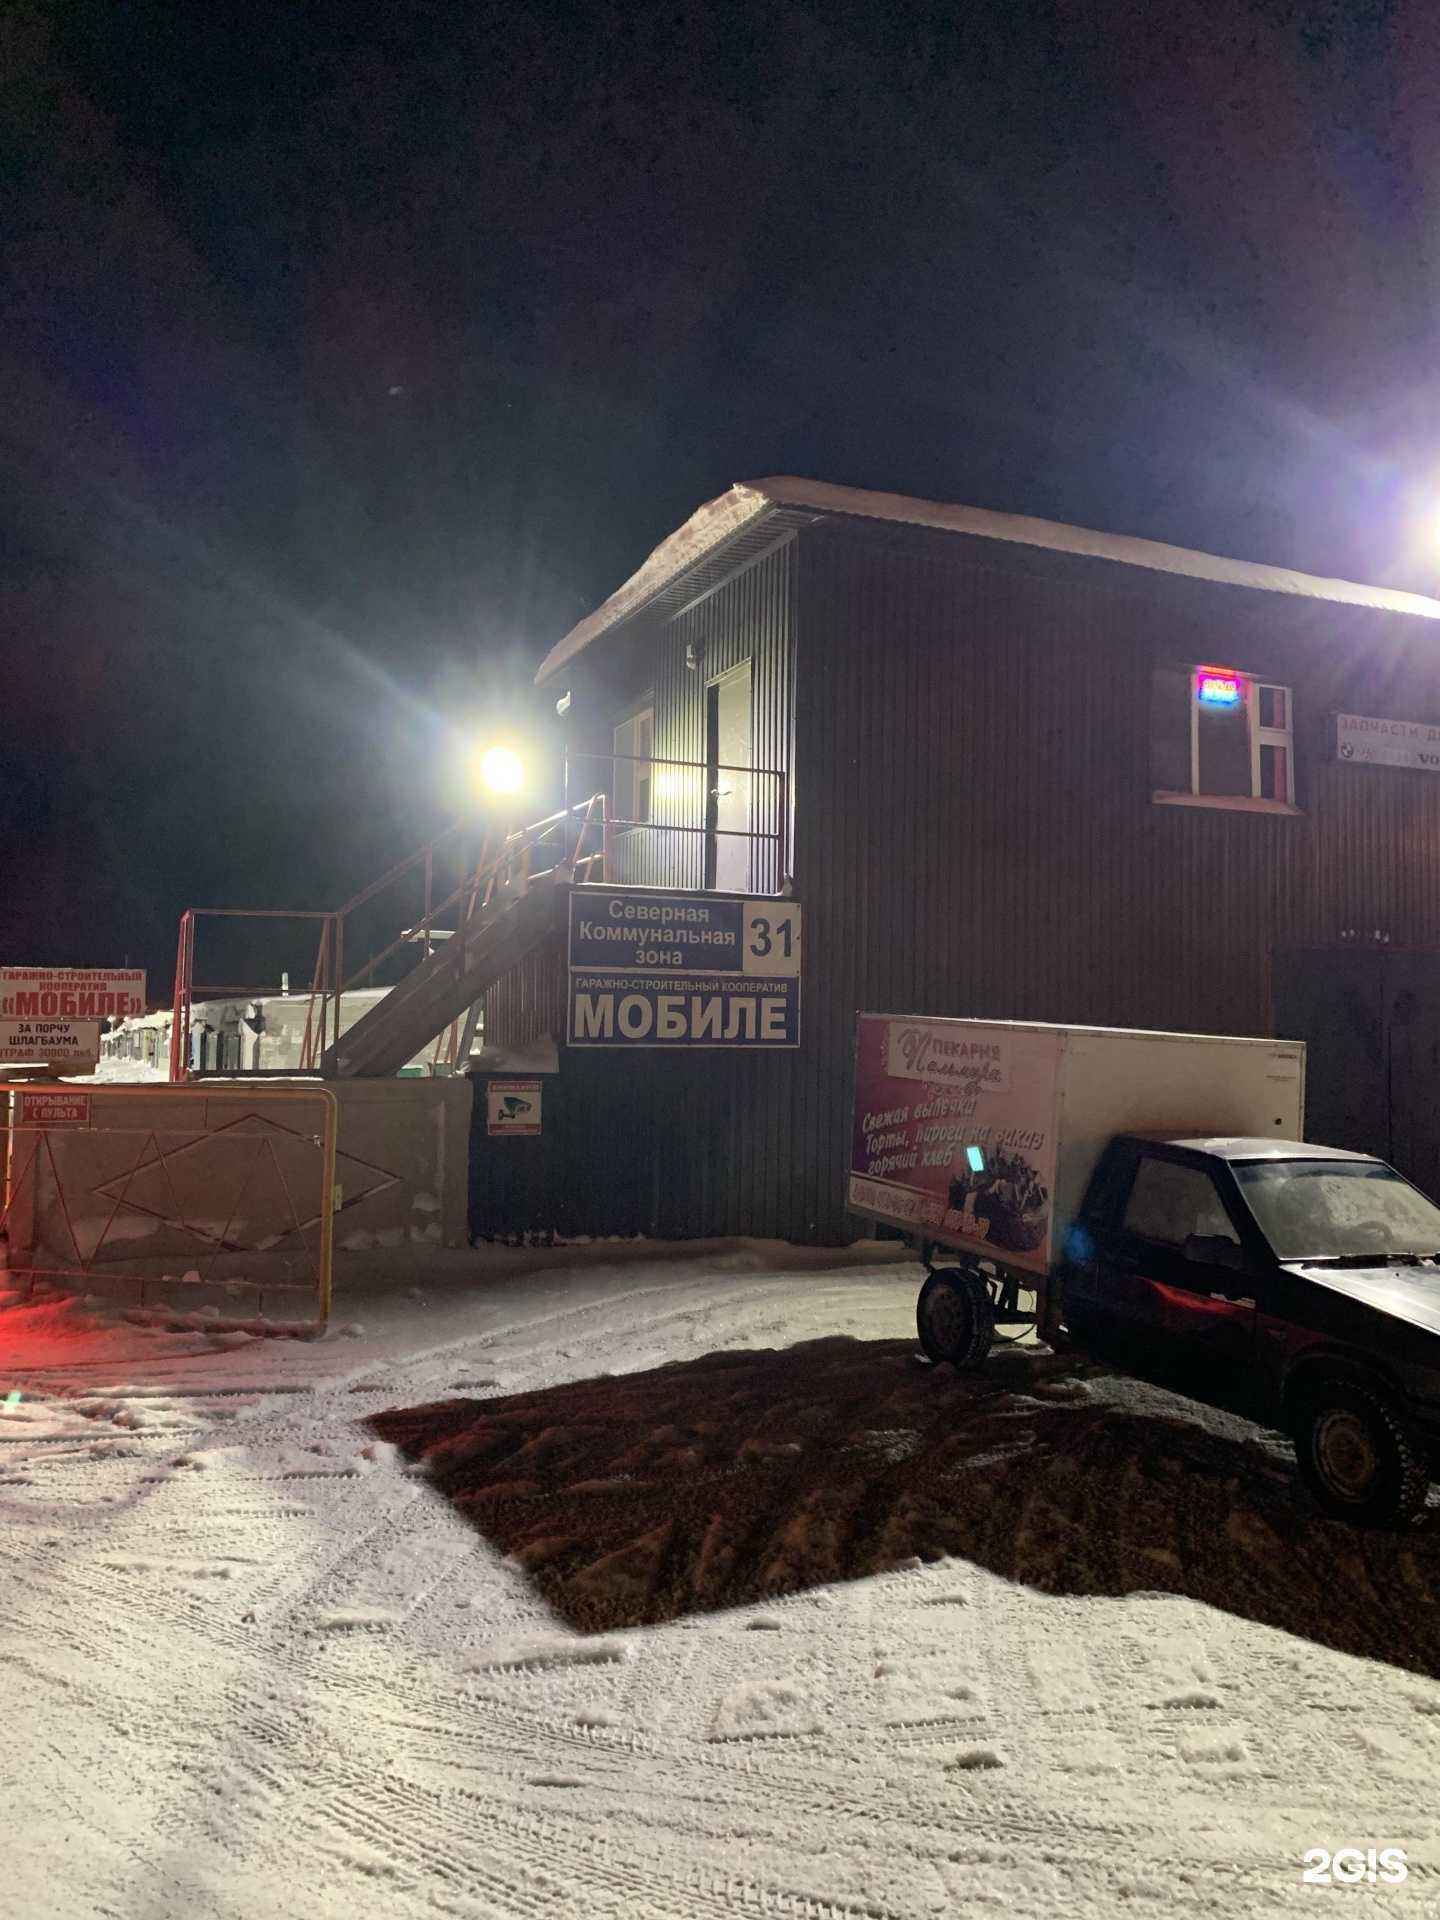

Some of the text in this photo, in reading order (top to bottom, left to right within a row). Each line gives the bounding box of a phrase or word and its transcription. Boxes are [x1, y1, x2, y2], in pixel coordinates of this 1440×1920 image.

[608, 900, 710, 923] Северная
[579, 921, 736, 946] Коммунальная
[750, 918, 792, 958] 31
[635, 951, 683, 966] зона
[2, 971, 144, 981] ГАРАЖНО-СТРОИТЕЛЬНЫЙ
[40, 982, 107, 991] КООПЕРАТИВ
[576, 978, 788, 993] ГАРАЖНО-СТРОИТЕЛЬНЫЙ КООПЕРАТИВ
[574, 994, 787, 1039] МОБИЛЕ
[18, 1023, 70, 1033] ЗА ПОРЧУ
[9, 1036, 79, 1046] ШЛАГБАУМА
[932, 1039, 1001, 1060] ПЕКАРНЯ
[24, 1095, 86, 1106] ОТКРЫВАНИЕ
[41, 1107, 78, 1119] ПУЛЬТА
